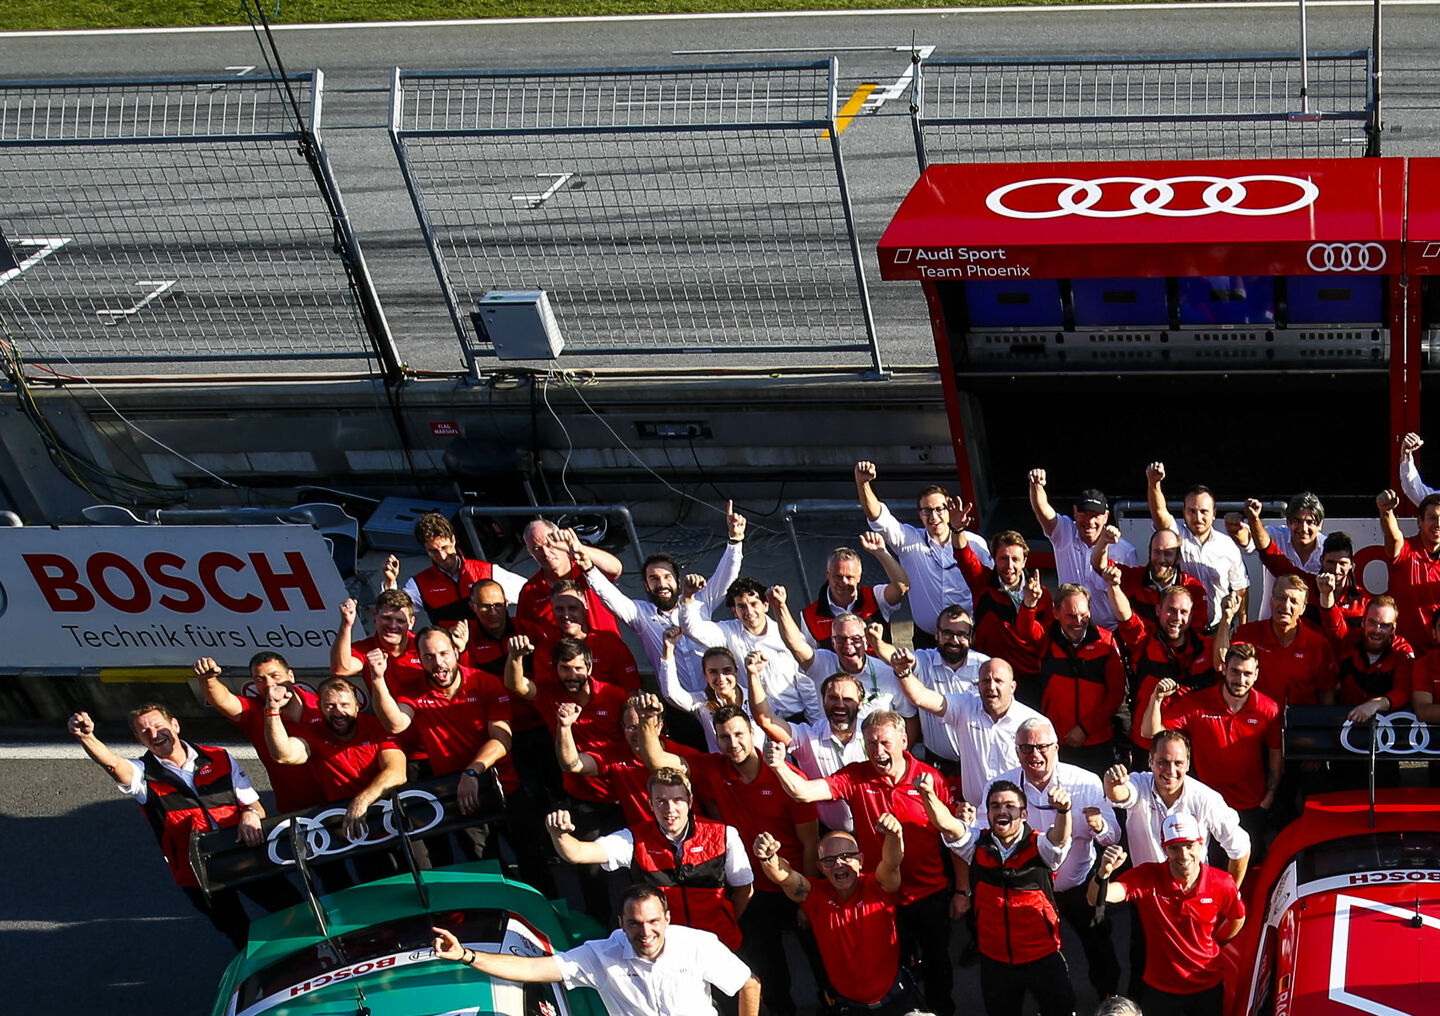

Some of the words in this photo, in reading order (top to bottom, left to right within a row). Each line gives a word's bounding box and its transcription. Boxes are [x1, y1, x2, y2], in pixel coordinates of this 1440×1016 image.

[916, 248, 954, 260] Audi
[958, 248, 1006, 262] Sport
[917, 265, 962, 278] Team
[966, 264, 1030, 277] Phoenix
[22, 552, 326, 613] BOSCH
[61, 624, 185, 648] Technik
[183, 624, 245, 648] fürs
[249, 624, 338, 648] Leben
[290, 957, 396, 998] BOSCH
